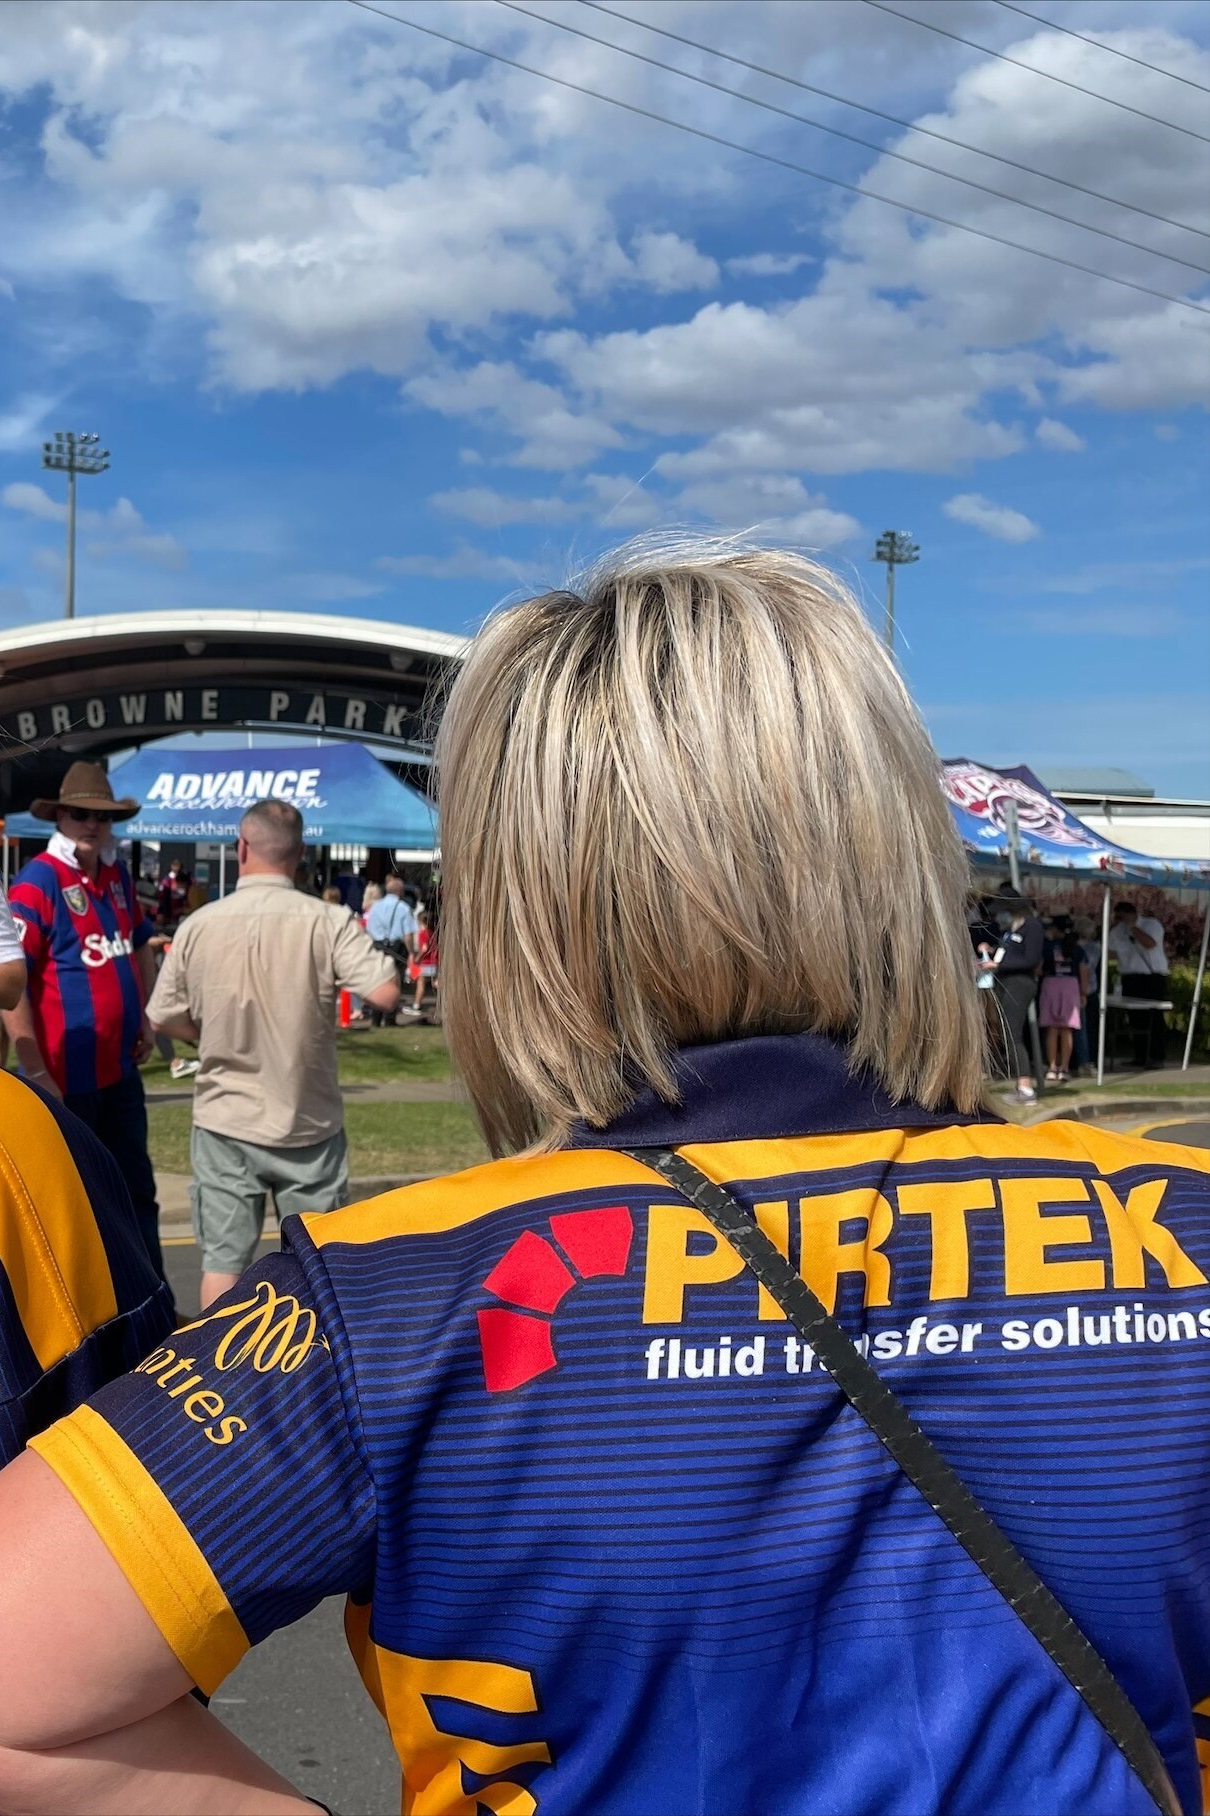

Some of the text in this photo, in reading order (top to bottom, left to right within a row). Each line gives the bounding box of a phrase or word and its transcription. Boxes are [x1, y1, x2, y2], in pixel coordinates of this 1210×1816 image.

[17, 689, 408, 741] BROWNE PARK
[146, 768, 321, 800] ADVANCE
[644, 1335, 766, 1380] fluid
[784, 1316, 983, 1374] trsfer
